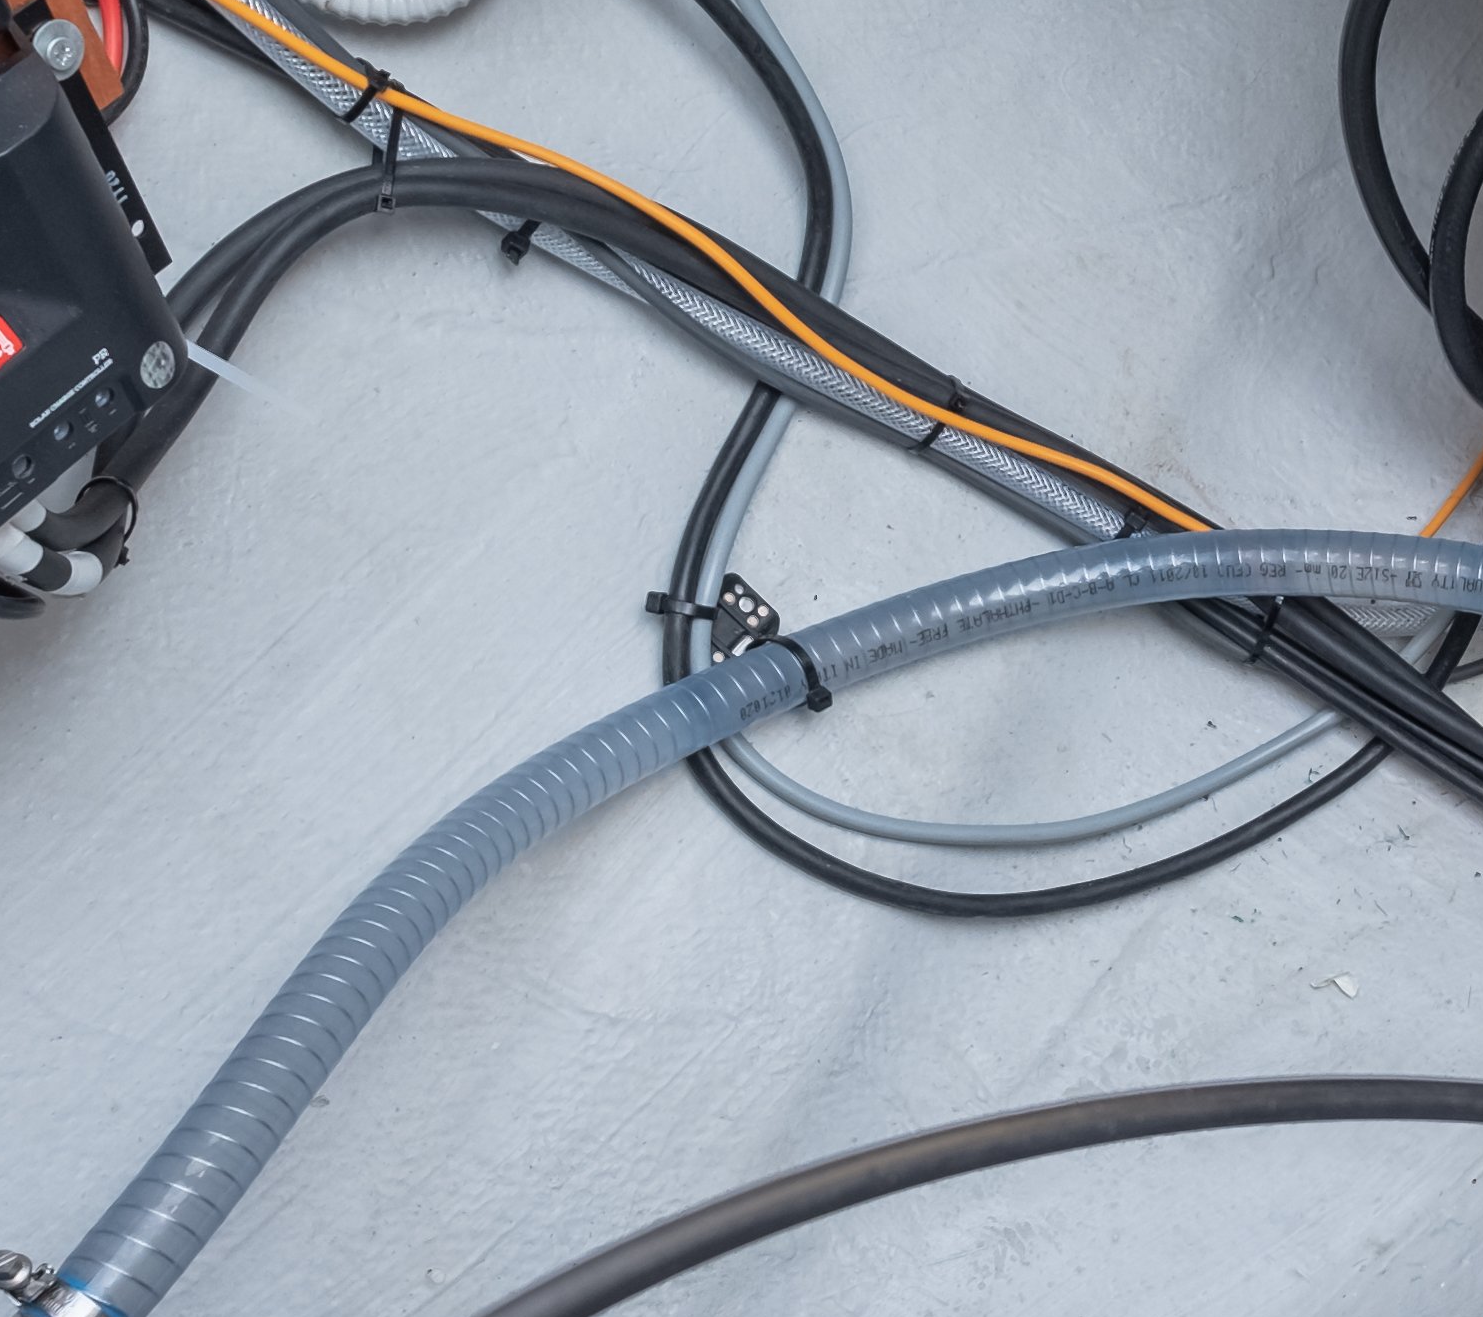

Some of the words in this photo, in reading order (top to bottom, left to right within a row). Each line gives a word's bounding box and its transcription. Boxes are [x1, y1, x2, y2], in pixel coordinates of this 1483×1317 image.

[91, 346, 110, 365] PR
[1150, 564, 1207, 583] 10/2011
[1259, 562, 1286, 576] REG
[1330, 565, 1346, 578] 20
[1125, 573, 1140, 587] CL
[1048, 577, 1115, 606] A-B-C-D1
[867, 638, 904, 664] MADE
[842, 655, 861, 673] IN
